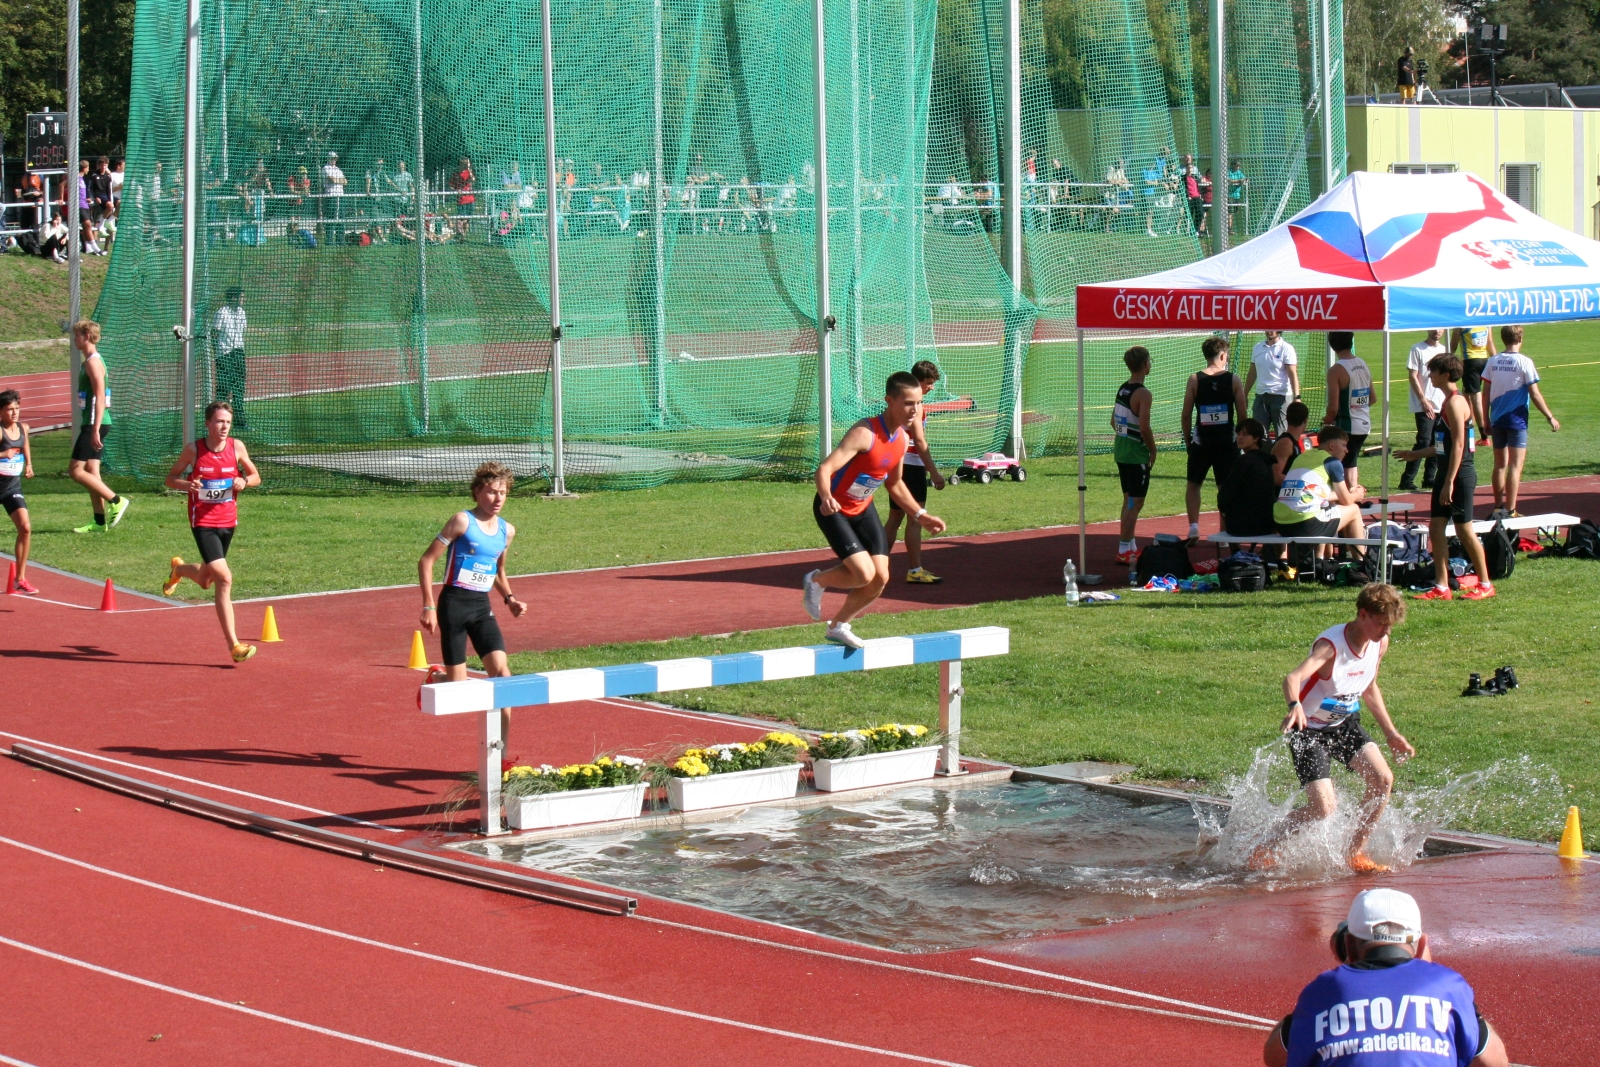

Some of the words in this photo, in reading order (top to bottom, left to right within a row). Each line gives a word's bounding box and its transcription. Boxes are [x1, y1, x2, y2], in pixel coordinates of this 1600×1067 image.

[1510, 240, 1544, 249] ČESKÝ
[1522, 247, 1575, 256] ATLETICKÝ
[1533, 255, 1562, 264] SVAZ
[1113, 289, 1174, 320] ČESKÝ
[1177, 290, 1281, 321] ATLETICKÝ
[1286, 294, 1338, 321] SVAZ
[1464, 290, 1519, 317] CZECH
[1522, 288, 1594, 315] ATHLETIC
[1356, 396, 1368, 405] 480
[206, 490, 226, 500] 497
[1283, 488, 1296, 497] 121
[471, 572, 488, 584] 586
[1315, 995, 1452, 1042] FOTO/TV
[1317, 1032, 1450, 1062] www.atletika.cz
